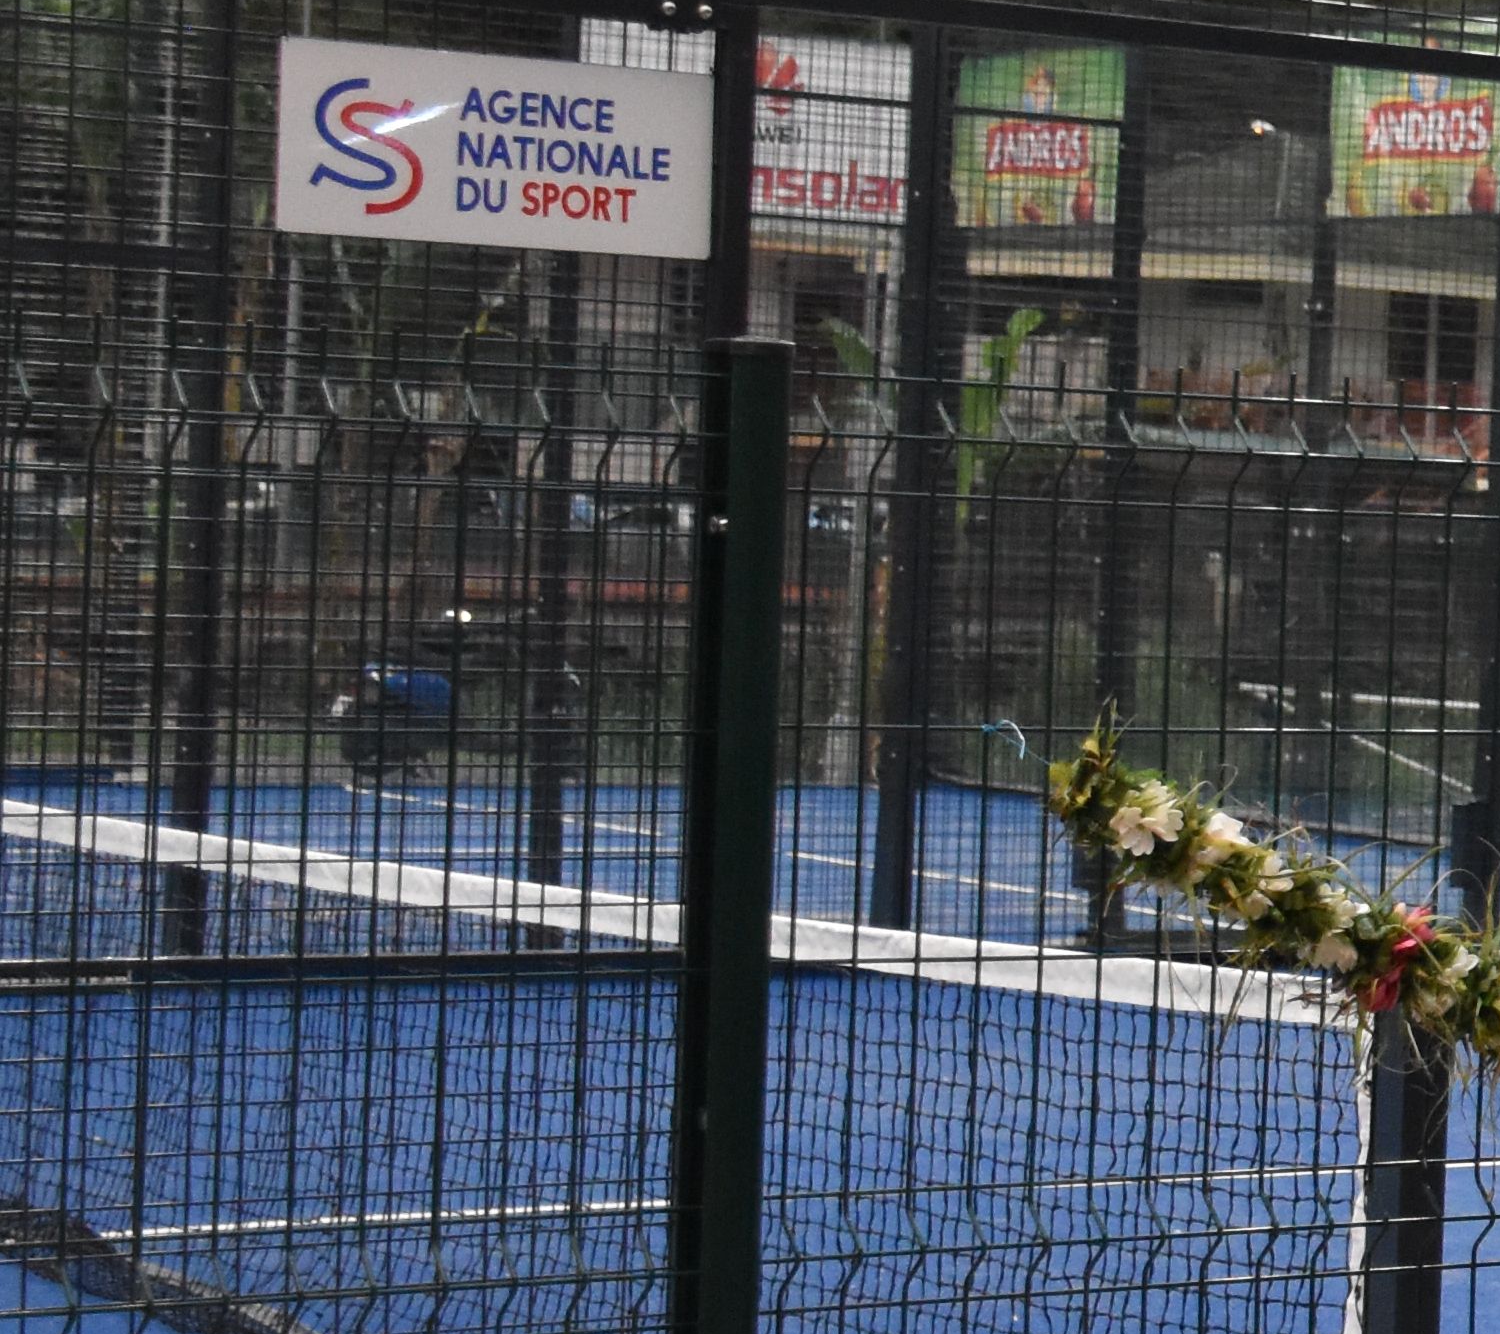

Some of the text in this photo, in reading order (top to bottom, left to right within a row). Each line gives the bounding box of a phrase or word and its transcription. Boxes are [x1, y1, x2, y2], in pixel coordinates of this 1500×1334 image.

[459, 87, 615, 133] AGENCE
[1367, 103, 1490, 155] ANDROS
[457, 131, 671, 181] NATIONALE
[456, 177, 637, 223] DU SPORT
